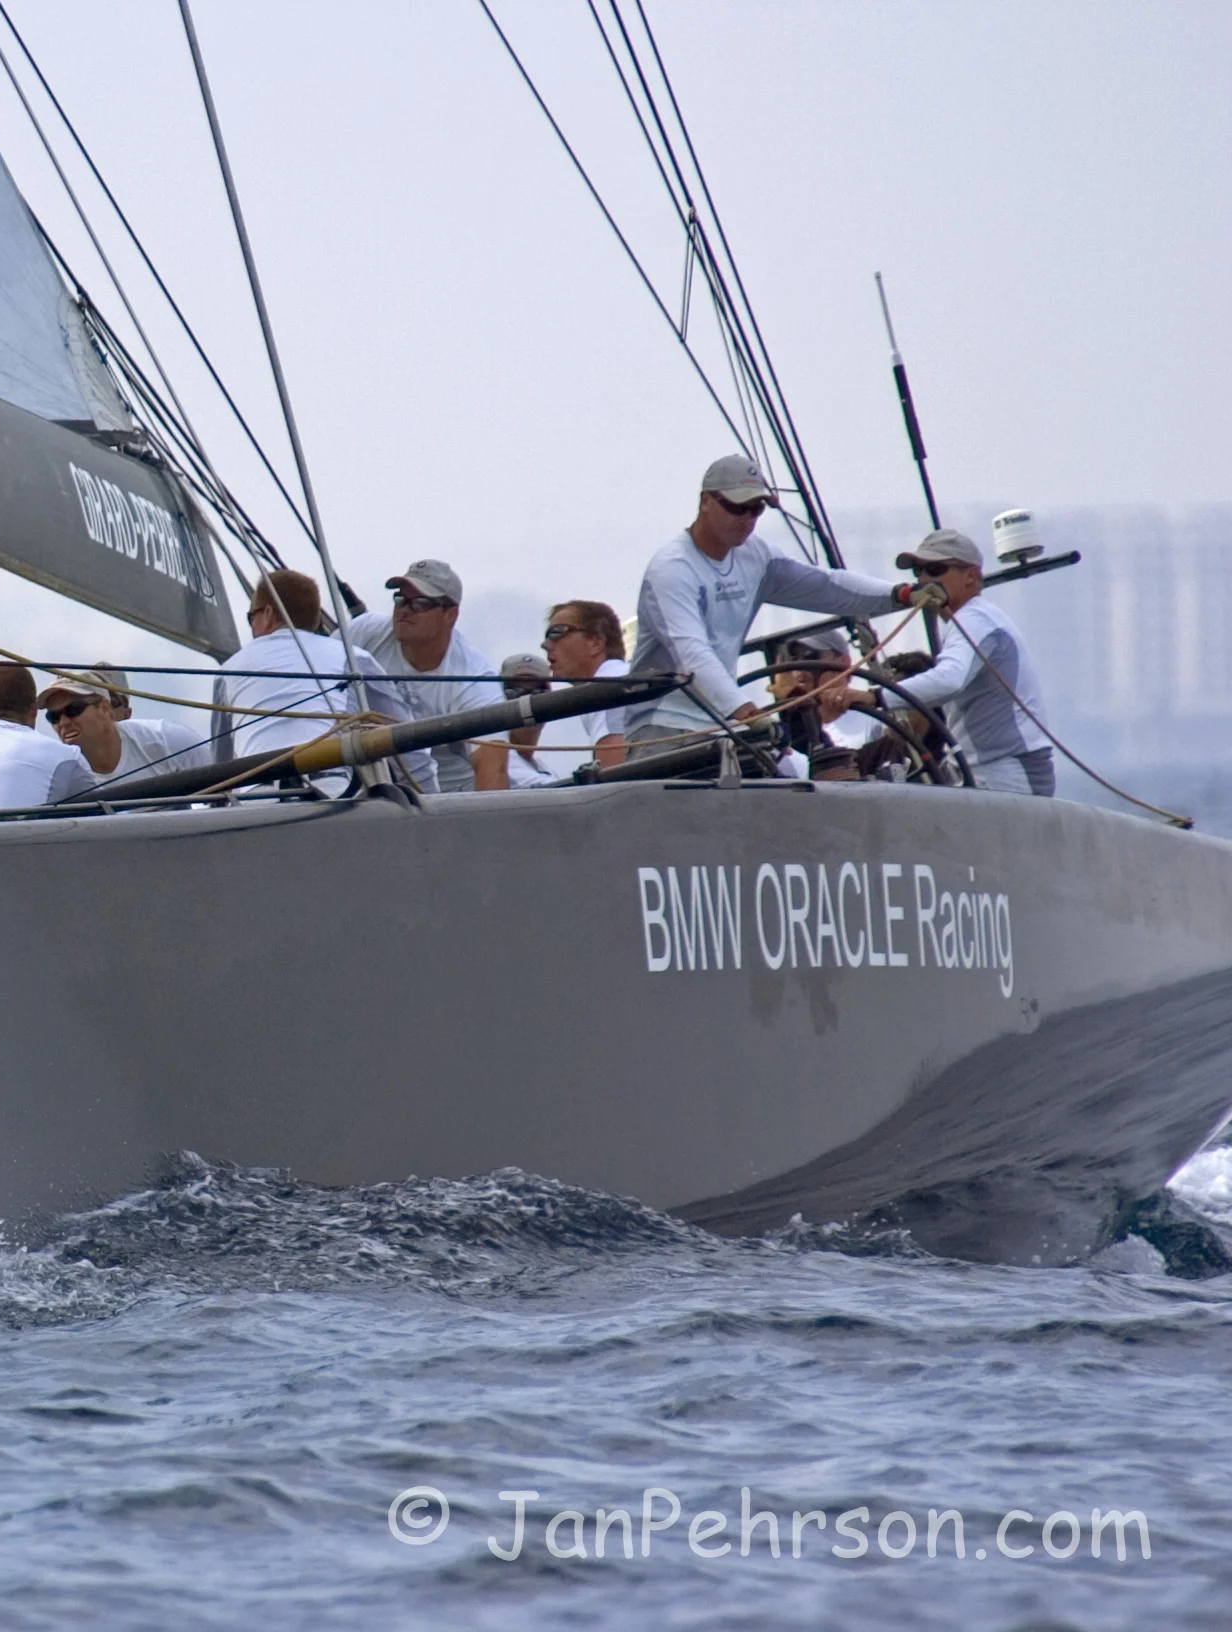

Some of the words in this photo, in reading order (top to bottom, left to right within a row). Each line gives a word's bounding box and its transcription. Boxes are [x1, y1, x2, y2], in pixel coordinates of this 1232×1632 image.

[637, 865, 742, 972] BMW
[755, 861, 909, 971] ORACLE
[913, 863, 1014, 999] Racing
